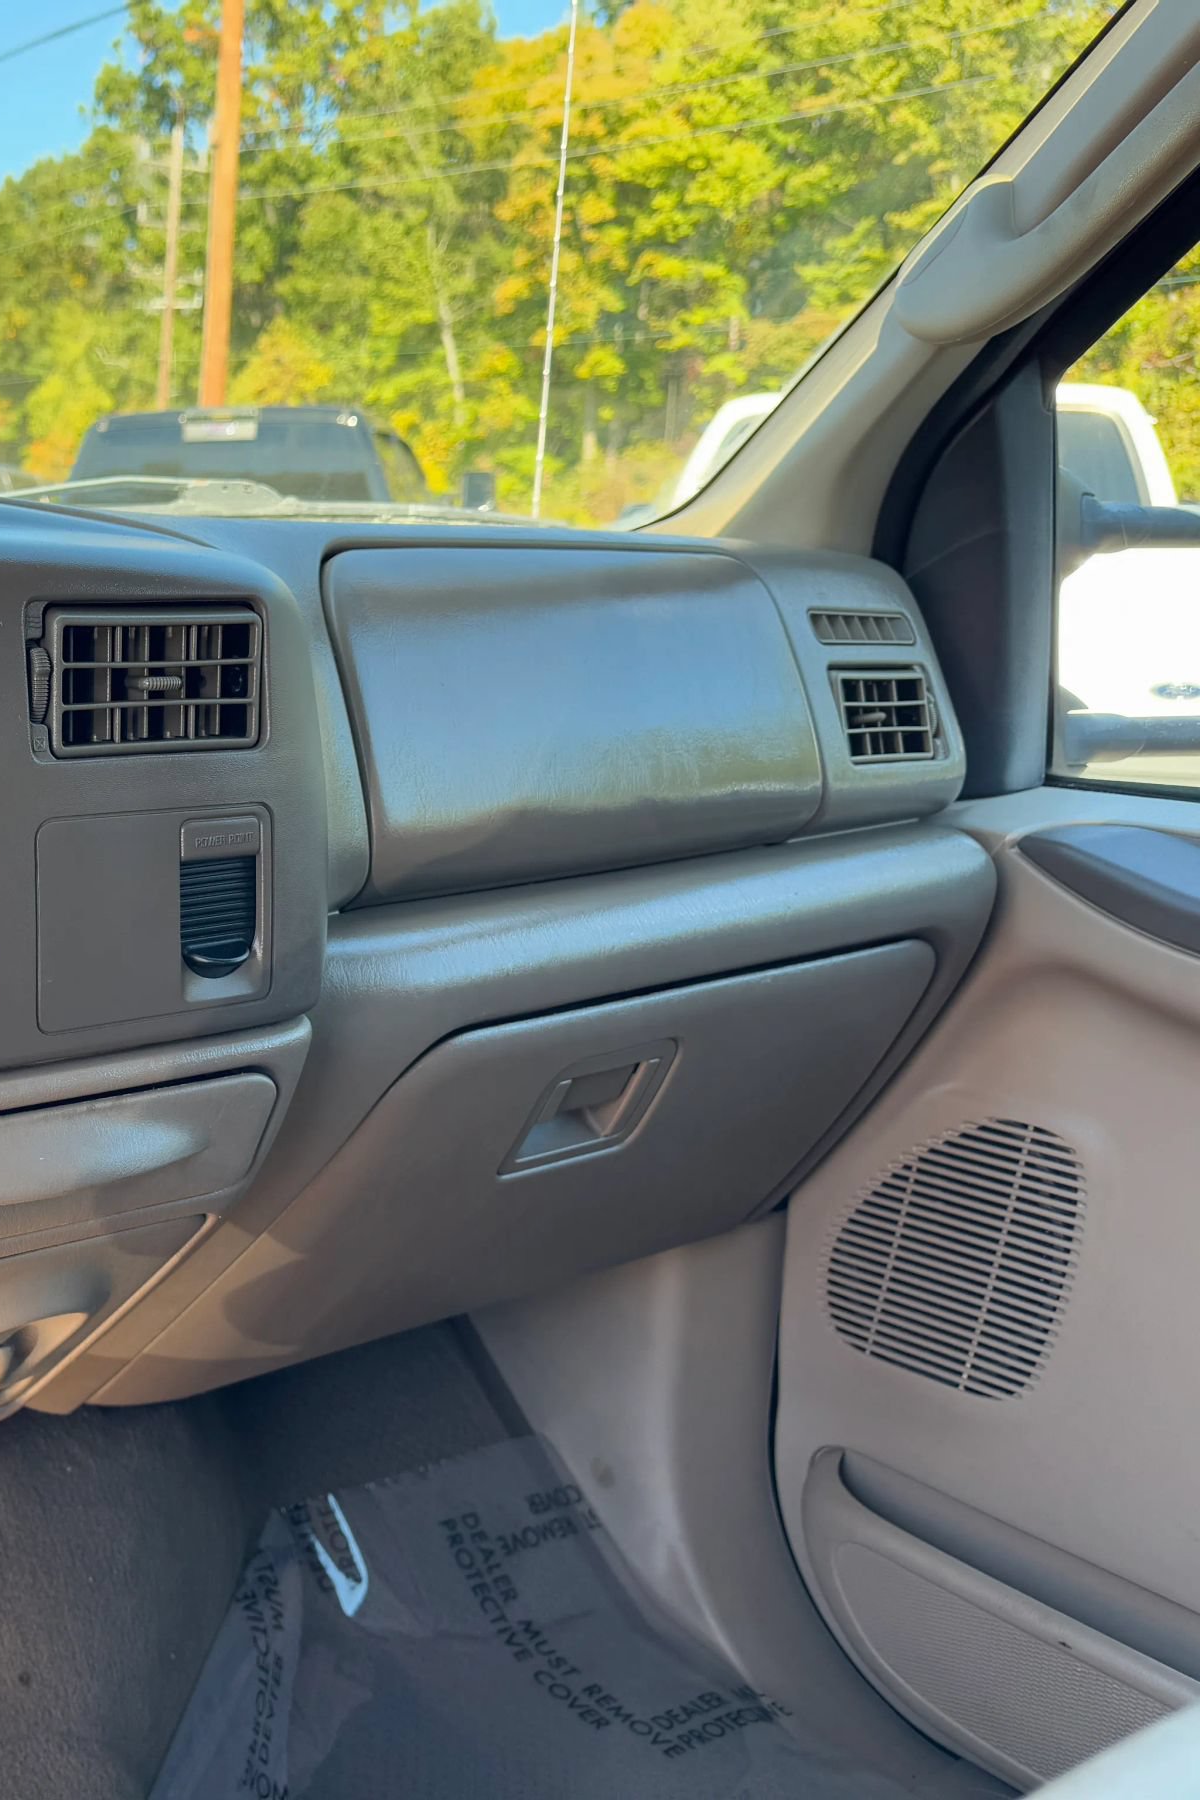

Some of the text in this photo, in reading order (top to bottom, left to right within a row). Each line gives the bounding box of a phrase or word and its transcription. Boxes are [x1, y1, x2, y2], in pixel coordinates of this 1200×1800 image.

[195, 831, 254, 849] POWER POINT
[438, 1517, 611, 1731] PROTECTIVE COVER
[460, 1511, 687, 1759] DEALER MUST REMOVE
